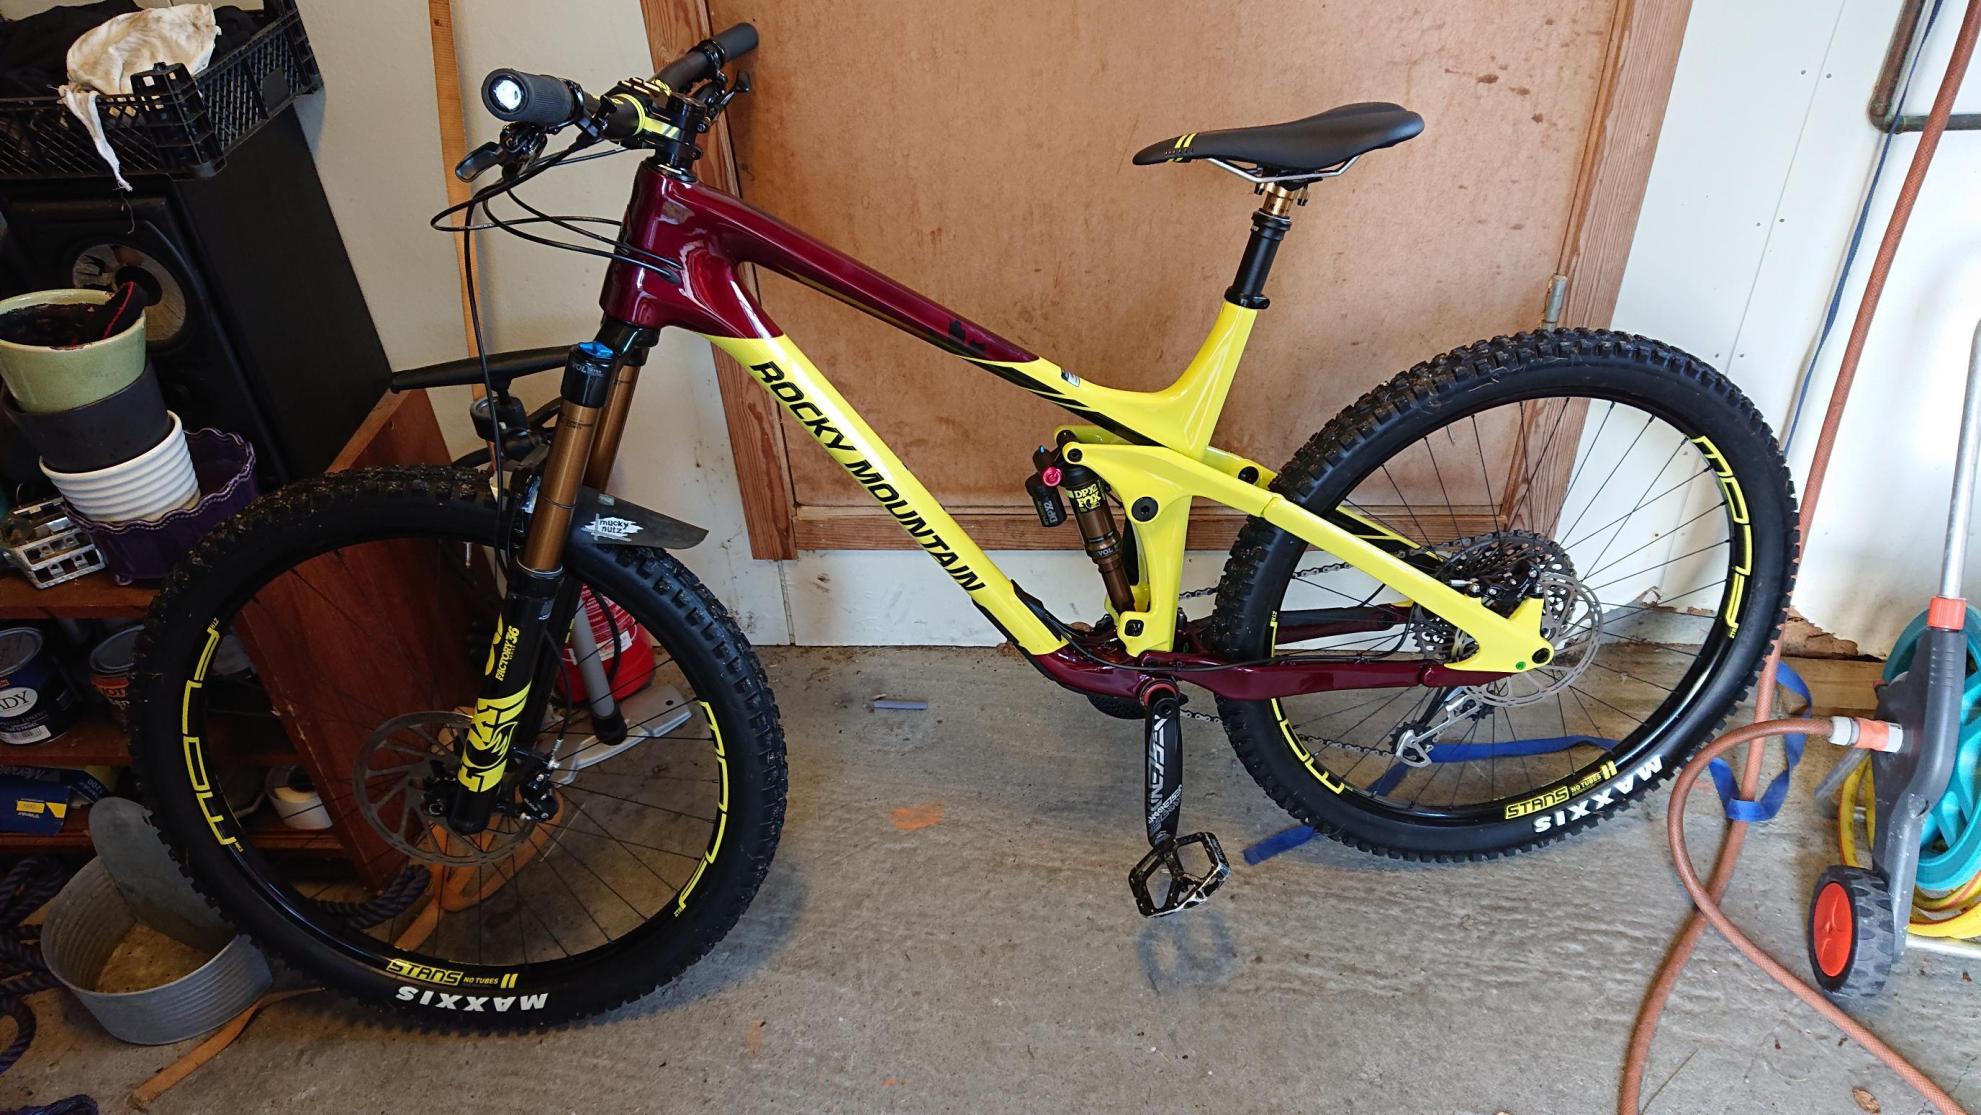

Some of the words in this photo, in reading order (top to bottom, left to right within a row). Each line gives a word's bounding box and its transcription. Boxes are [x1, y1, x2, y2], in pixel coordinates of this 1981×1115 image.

[750, 361, 856, 451] ROCKY
[845, 459, 987, 592] MOUNTAIN
[1077, 491, 1102, 508] FOX
[599, 519, 629, 530] mucky
[601, 526, 623, 534] nutz
[495, 642, 513, 682] FACTORY
[507, 625, 520, 645] 36
[1506, 786, 1570, 820] STANS
[1581, 772, 1602, 788] TUBES
[1533, 754, 1663, 834] MAXXIS
[386, 958, 464, 987] STANS
[475, 977, 499, 985] TUBES
[395, 985, 549, 1013] MAXXIS
